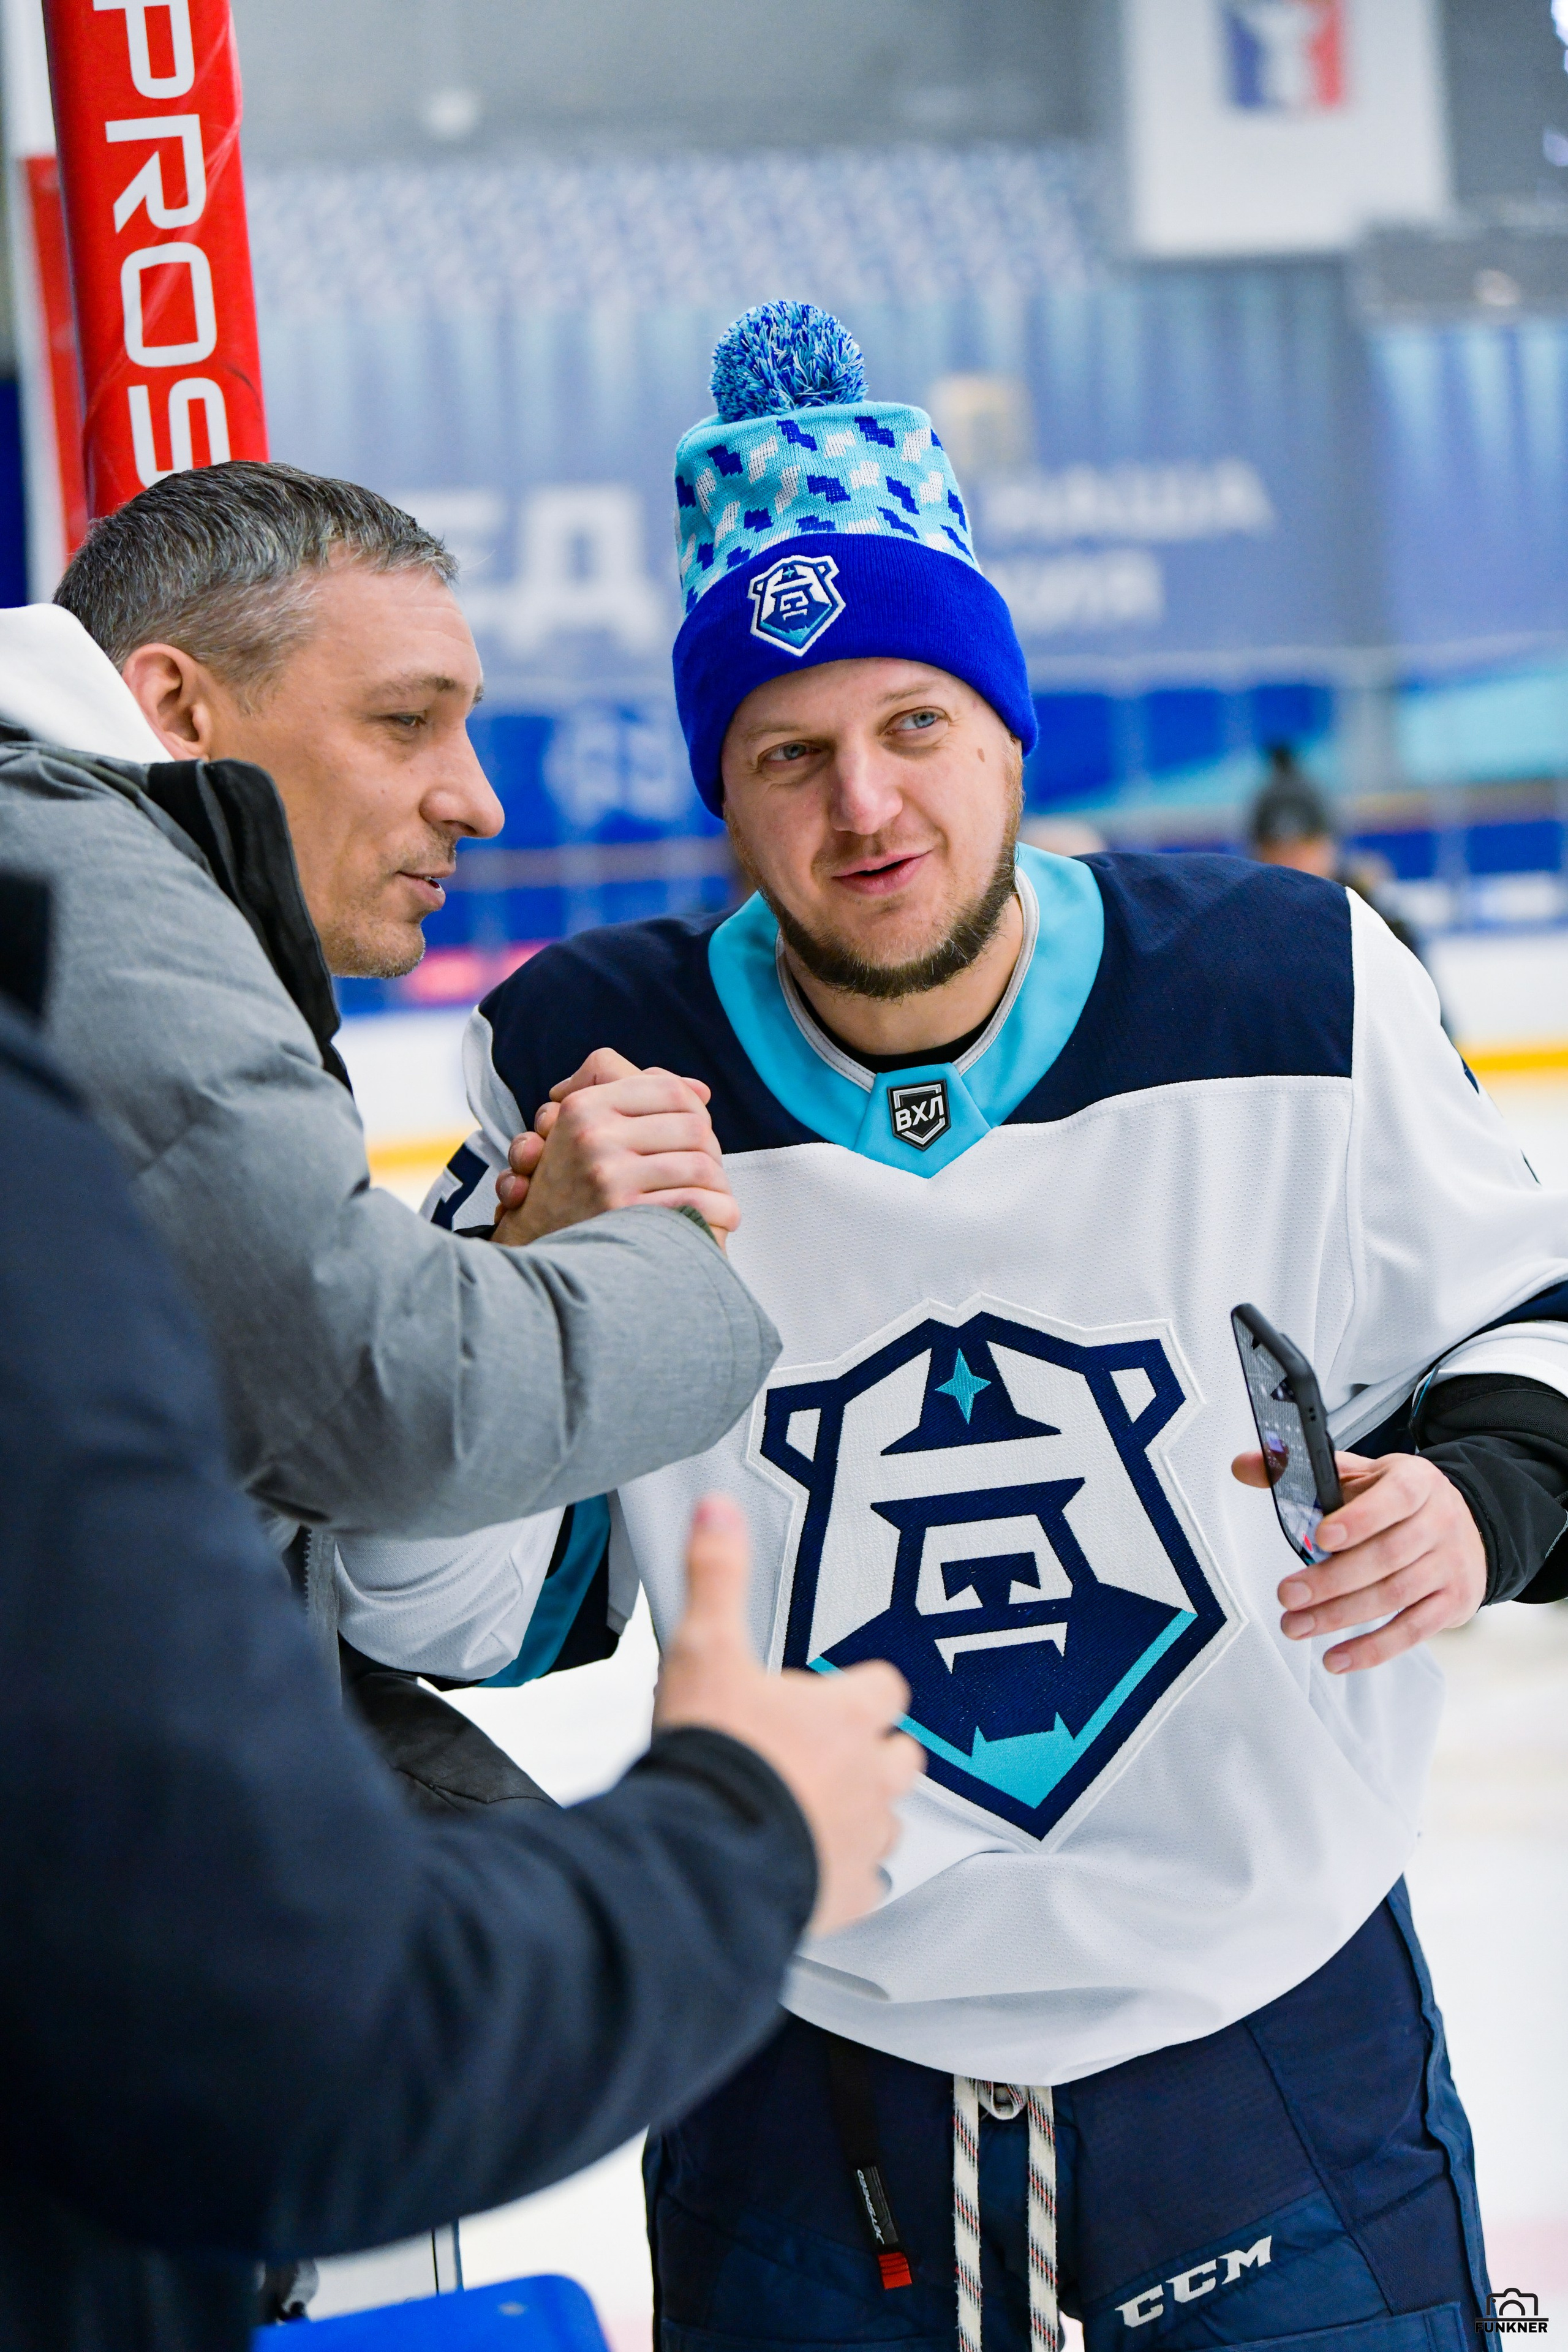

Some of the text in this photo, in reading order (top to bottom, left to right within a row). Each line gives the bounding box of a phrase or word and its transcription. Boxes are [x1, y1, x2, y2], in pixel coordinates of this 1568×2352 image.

[895, 1095, 944, 1131] ВХЛ
[858, 2169, 885, 2245] JETSPEED
[1115, 2235, 1272, 2328] CCM
